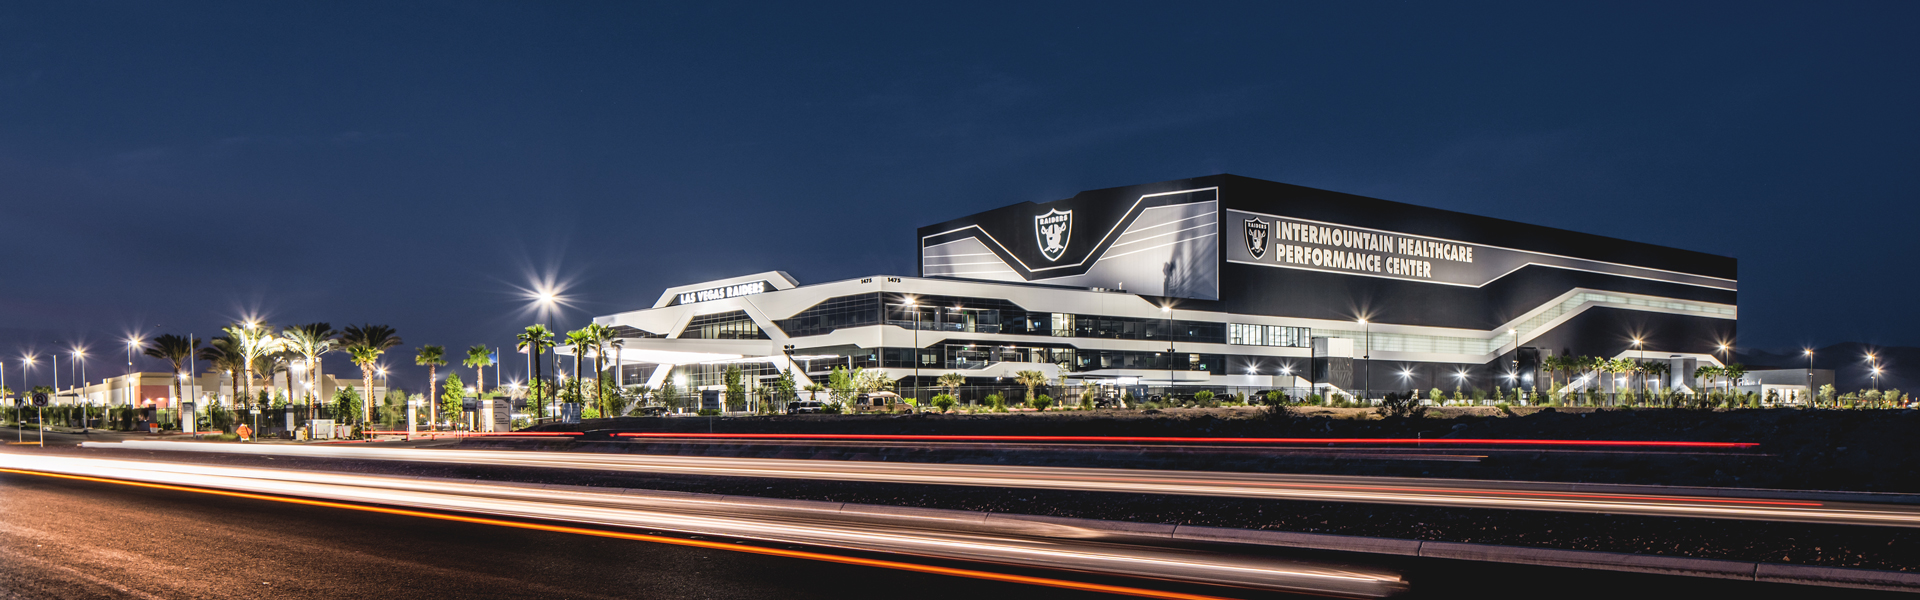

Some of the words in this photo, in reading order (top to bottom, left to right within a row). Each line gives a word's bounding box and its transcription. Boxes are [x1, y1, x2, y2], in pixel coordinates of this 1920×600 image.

[1039, 214, 1068, 225] RAIDERS
[1275, 220, 1394, 253] INTERMOUNTAIN
[1398, 237, 1473, 263] HEALTHCARE
[1276, 243, 1381, 273] PERFORMANCE
[1385, 256, 1432, 278] CENTER
[680, 292, 696, 305] LAS
[697, 287, 725, 302] VEGAS
[726, 281, 765, 297] RAIDERS
